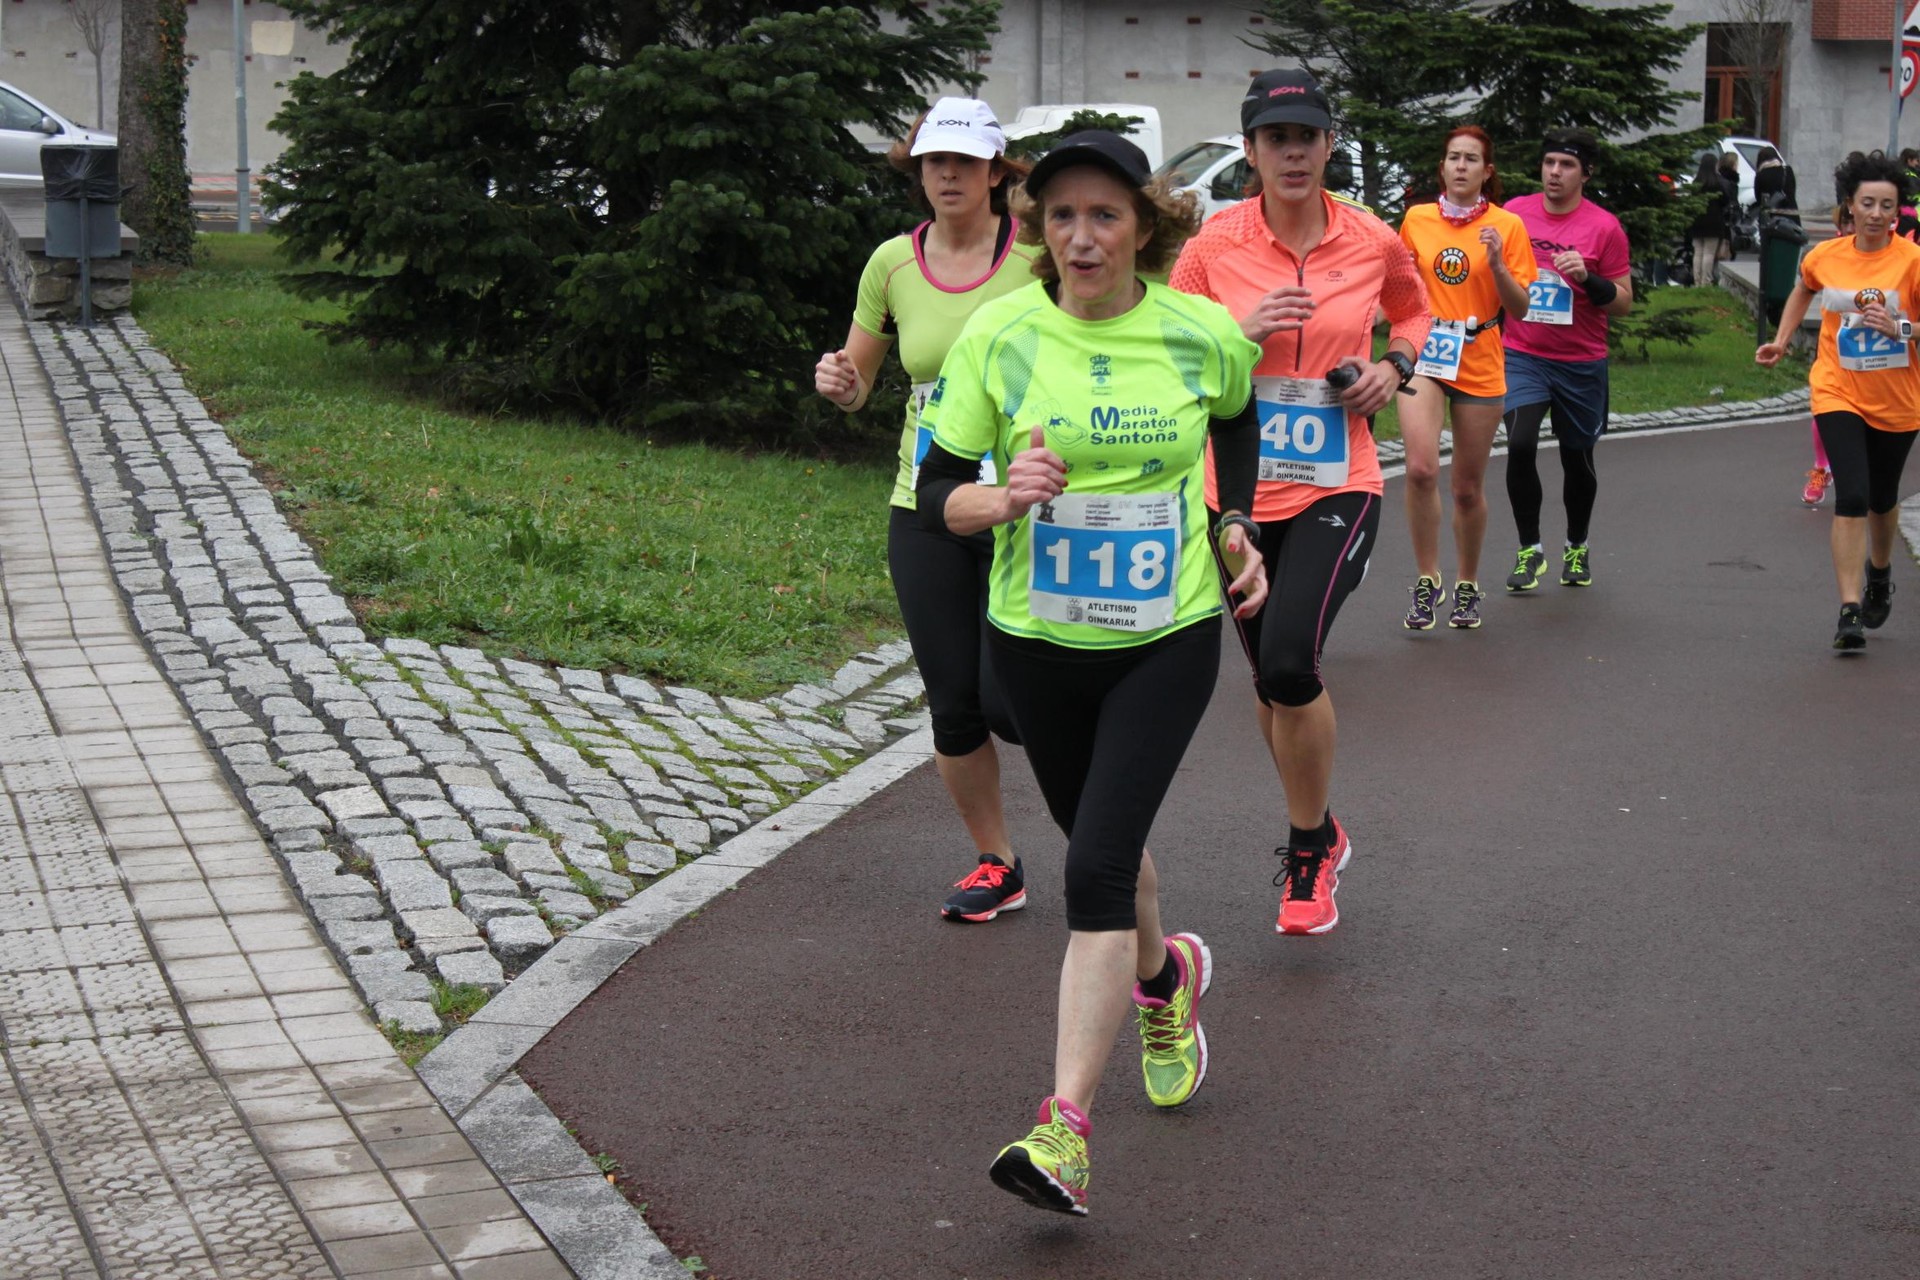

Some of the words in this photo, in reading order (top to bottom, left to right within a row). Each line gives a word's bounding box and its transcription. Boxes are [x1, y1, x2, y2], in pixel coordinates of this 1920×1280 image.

[1529, 285, 1558, 307] 27
[1423, 336, 1456, 362] 32
[1090, 429, 1178, 445] Santoña
[1260, 412, 1325, 455] 40
[1276, 462, 1316, 472] ATLETISMO
[1276, 473, 1316, 482] OINKARIAK
[1046, 538, 1167, 590] 118
[1087, 602, 1137, 613] ATLETISMO
[1087, 615, 1137, 628] OINKARIAK
